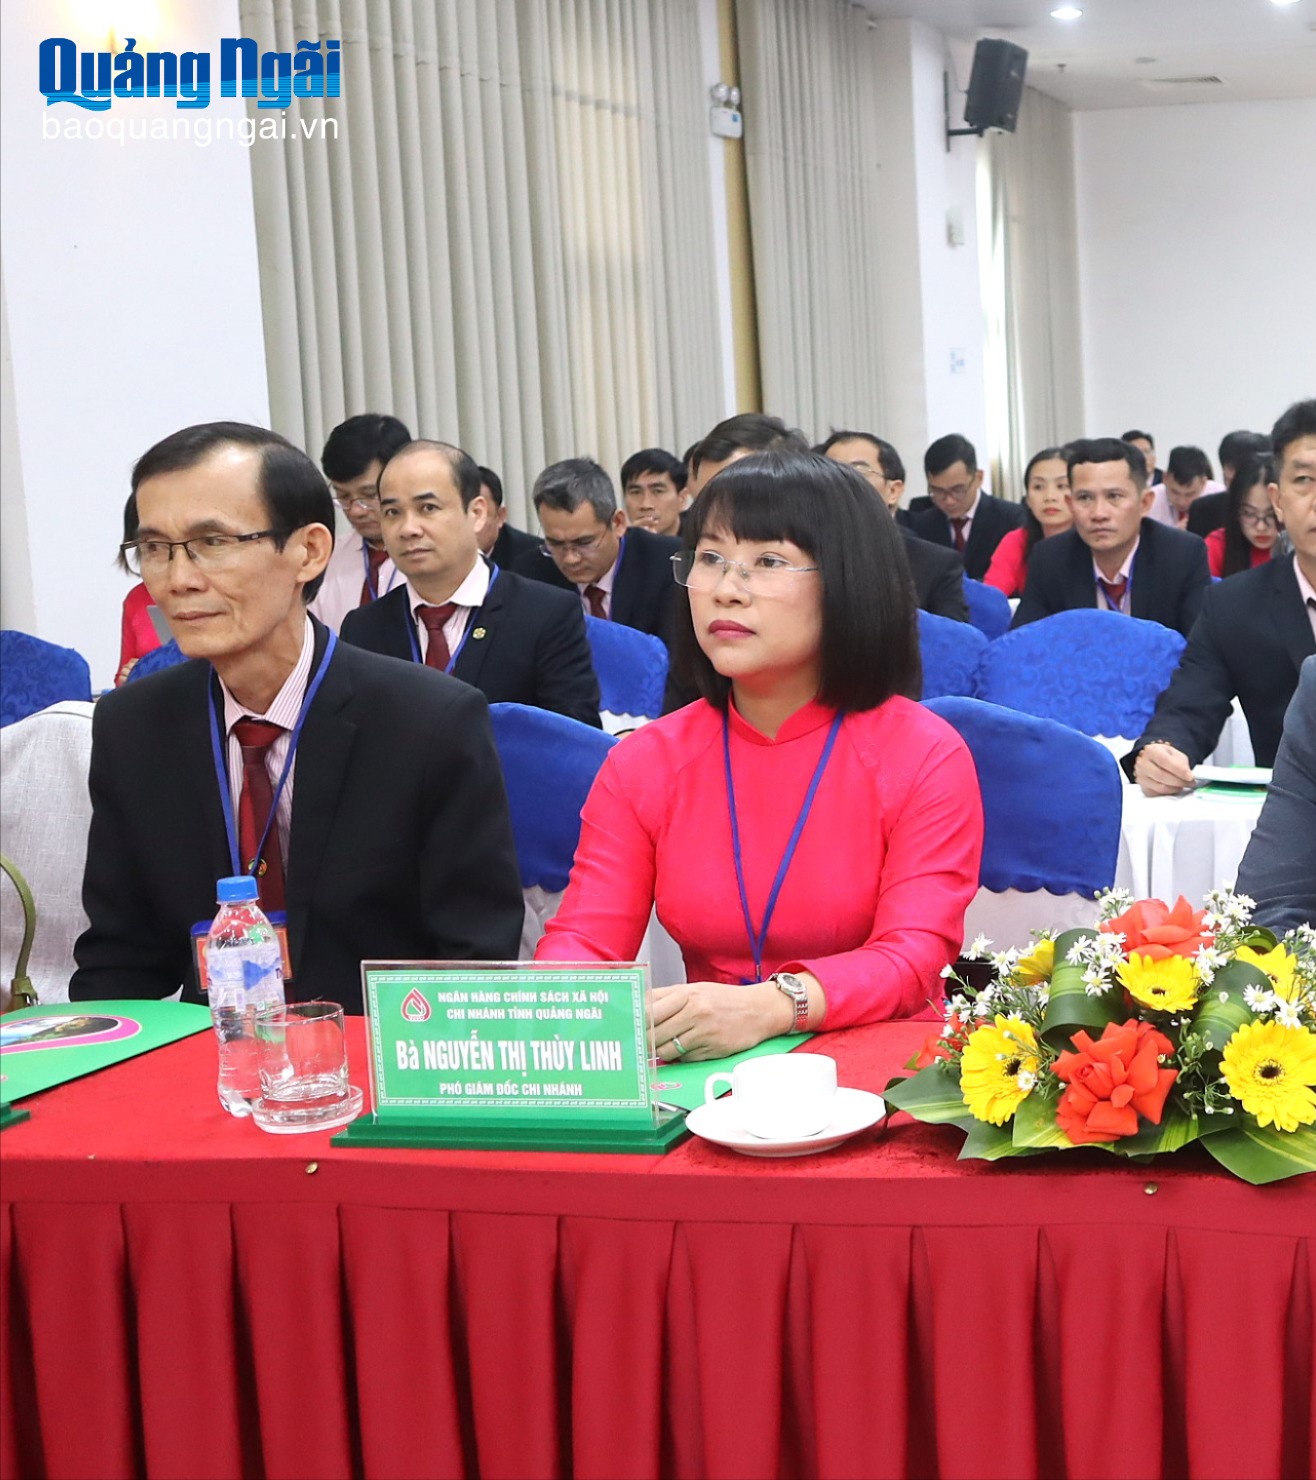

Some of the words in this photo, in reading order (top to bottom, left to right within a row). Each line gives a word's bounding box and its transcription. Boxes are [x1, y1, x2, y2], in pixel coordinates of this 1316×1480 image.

[438, 990, 469, 1003] NGÂN
[470, 990, 502, 1003] HÀNG
[503, 990, 538, 1003] CHÍNH
[539, 990, 570, 1003] SÁCH
[572, 989, 588, 1003] XÃ
[589, 989, 609, 1005] HỘI
[446, 1008, 466, 1020] CHI
[467, 1007, 506, 1020] NHÁNH
[507, 1005, 534, 1020] TỈNH
[535, 1005, 574, 1021] QUẢNG
[575, 1006, 603, 1020] NGÃI
[395, 1039, 420, 1070] Bà
[422, 1029, 495, 1071] NGUYỄN
[497, 1040, 528, 1077] THỊ
[529, 1034, 575, 1071] THÙY
[579, 1040, 623, 1071] LINH
[439, 1080, 463, 1095] PHÓ
[465, 1081, 494, 1096] GIÁM
[495, 1079, 519, 1096] ĐỐC
[522, 1083, 541, 1096] CHI
[542, 1082, 583, 1096] NHÁNH
